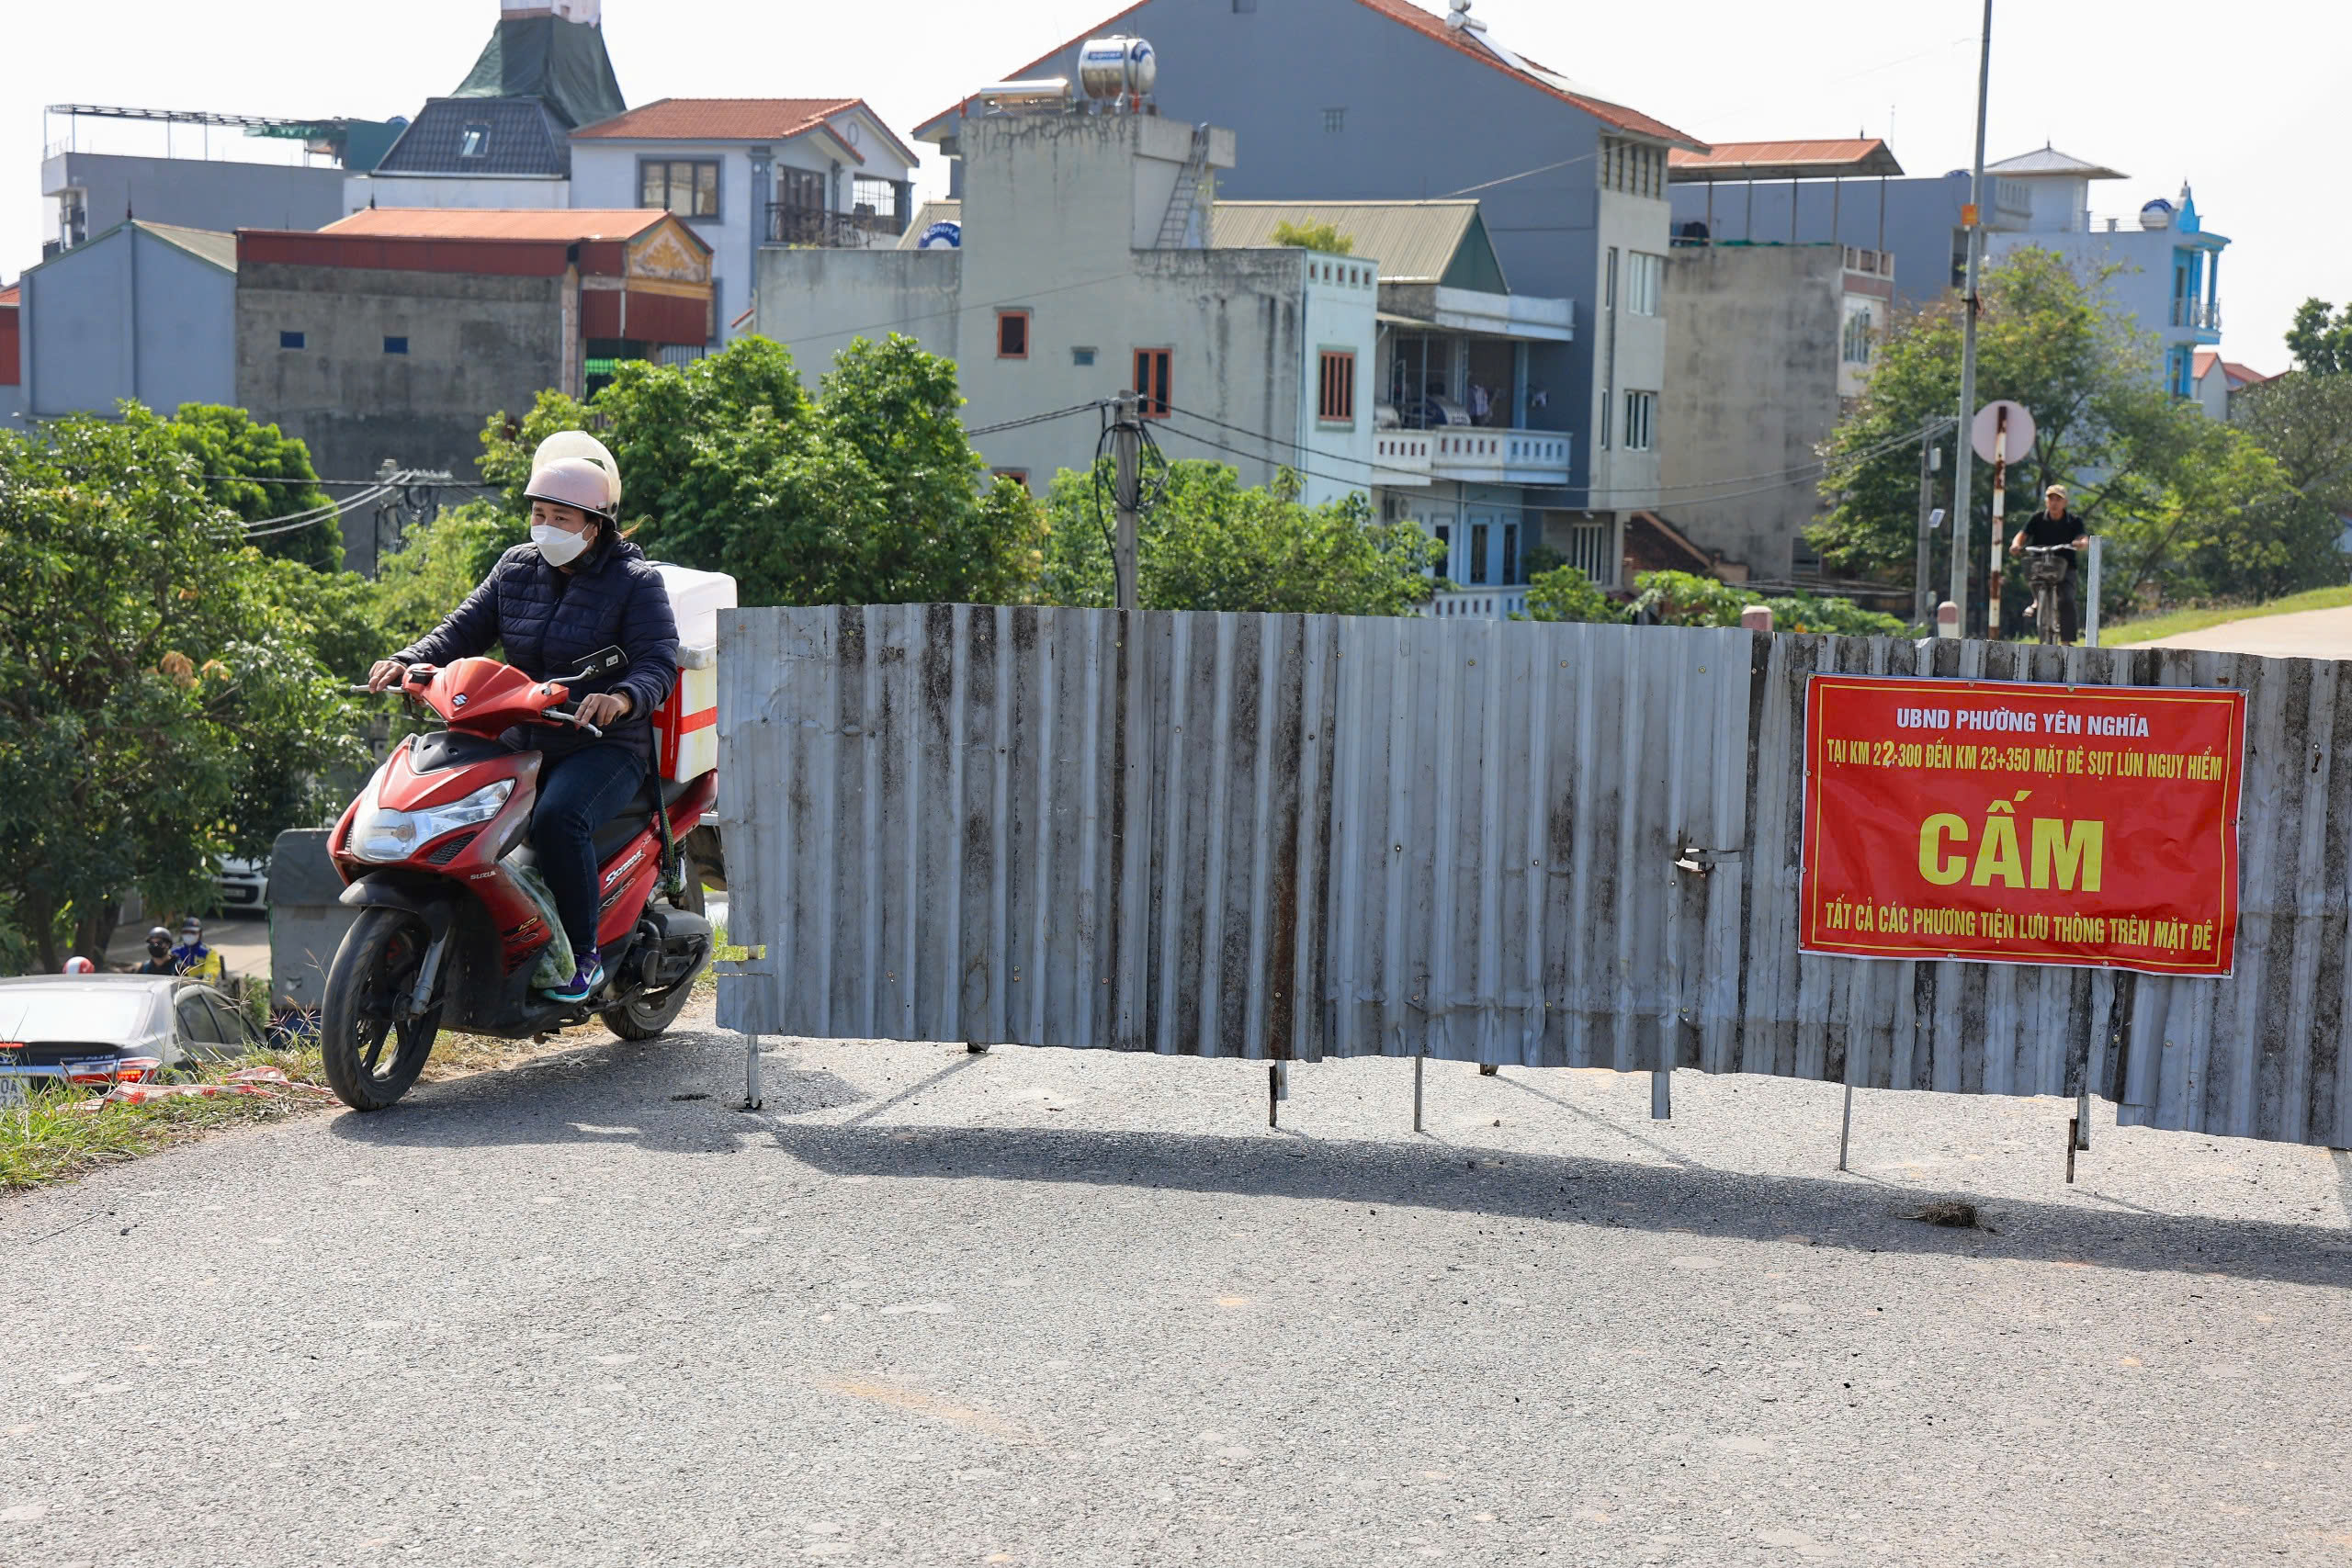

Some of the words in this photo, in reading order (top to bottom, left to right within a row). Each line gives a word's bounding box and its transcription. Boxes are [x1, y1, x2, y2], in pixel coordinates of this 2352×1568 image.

[1896, 708, 1950, 729] UBND
[1956, 706, 2037, 732] PHƯỜNG
[2042, 710, 2081, 734] YÊN
[2087, 714, 2150, 737] NGHĨA
[1826, 739, 1847, 768] TẠI
[1849, 740, 1870, 764] KM
[1926, 737, 1952, 769] ĐẾN
[1955, 745, 1977, 770] KM
[1980, 746, 2030, 772] 23+350
[2033, 743, 2064, 778] MẶT
[2066, 745, 2085, 774] ĐÊ
[2087, 750, 2114, 781] SỤT
[2117, 747, 2143, 777] LÚN
[2147, 753, 2185, 779] NGUY
[2187, 745, 2222, 781] HIỂM
[1918, 790, 2104, 893] CẤM
[1825, 893, 1852, 930] TẤT
[1855, 896, 1874, 932] CẢ
[1878, 901, 1909, 934] CÁC
[1913, 908, 1976, 937] PHƯƠNG
[1980, 908, 2015, 944] TIỆN
[2018, 912, 2049, 942] LƯU
[2052, 911, 2106, 944] THÔNG
[2109, 914, 2150, 946] TRÊN
[2154, 916, 2188, 955] MẶT
[2191, 919, 2213, 952] ĐÊ
